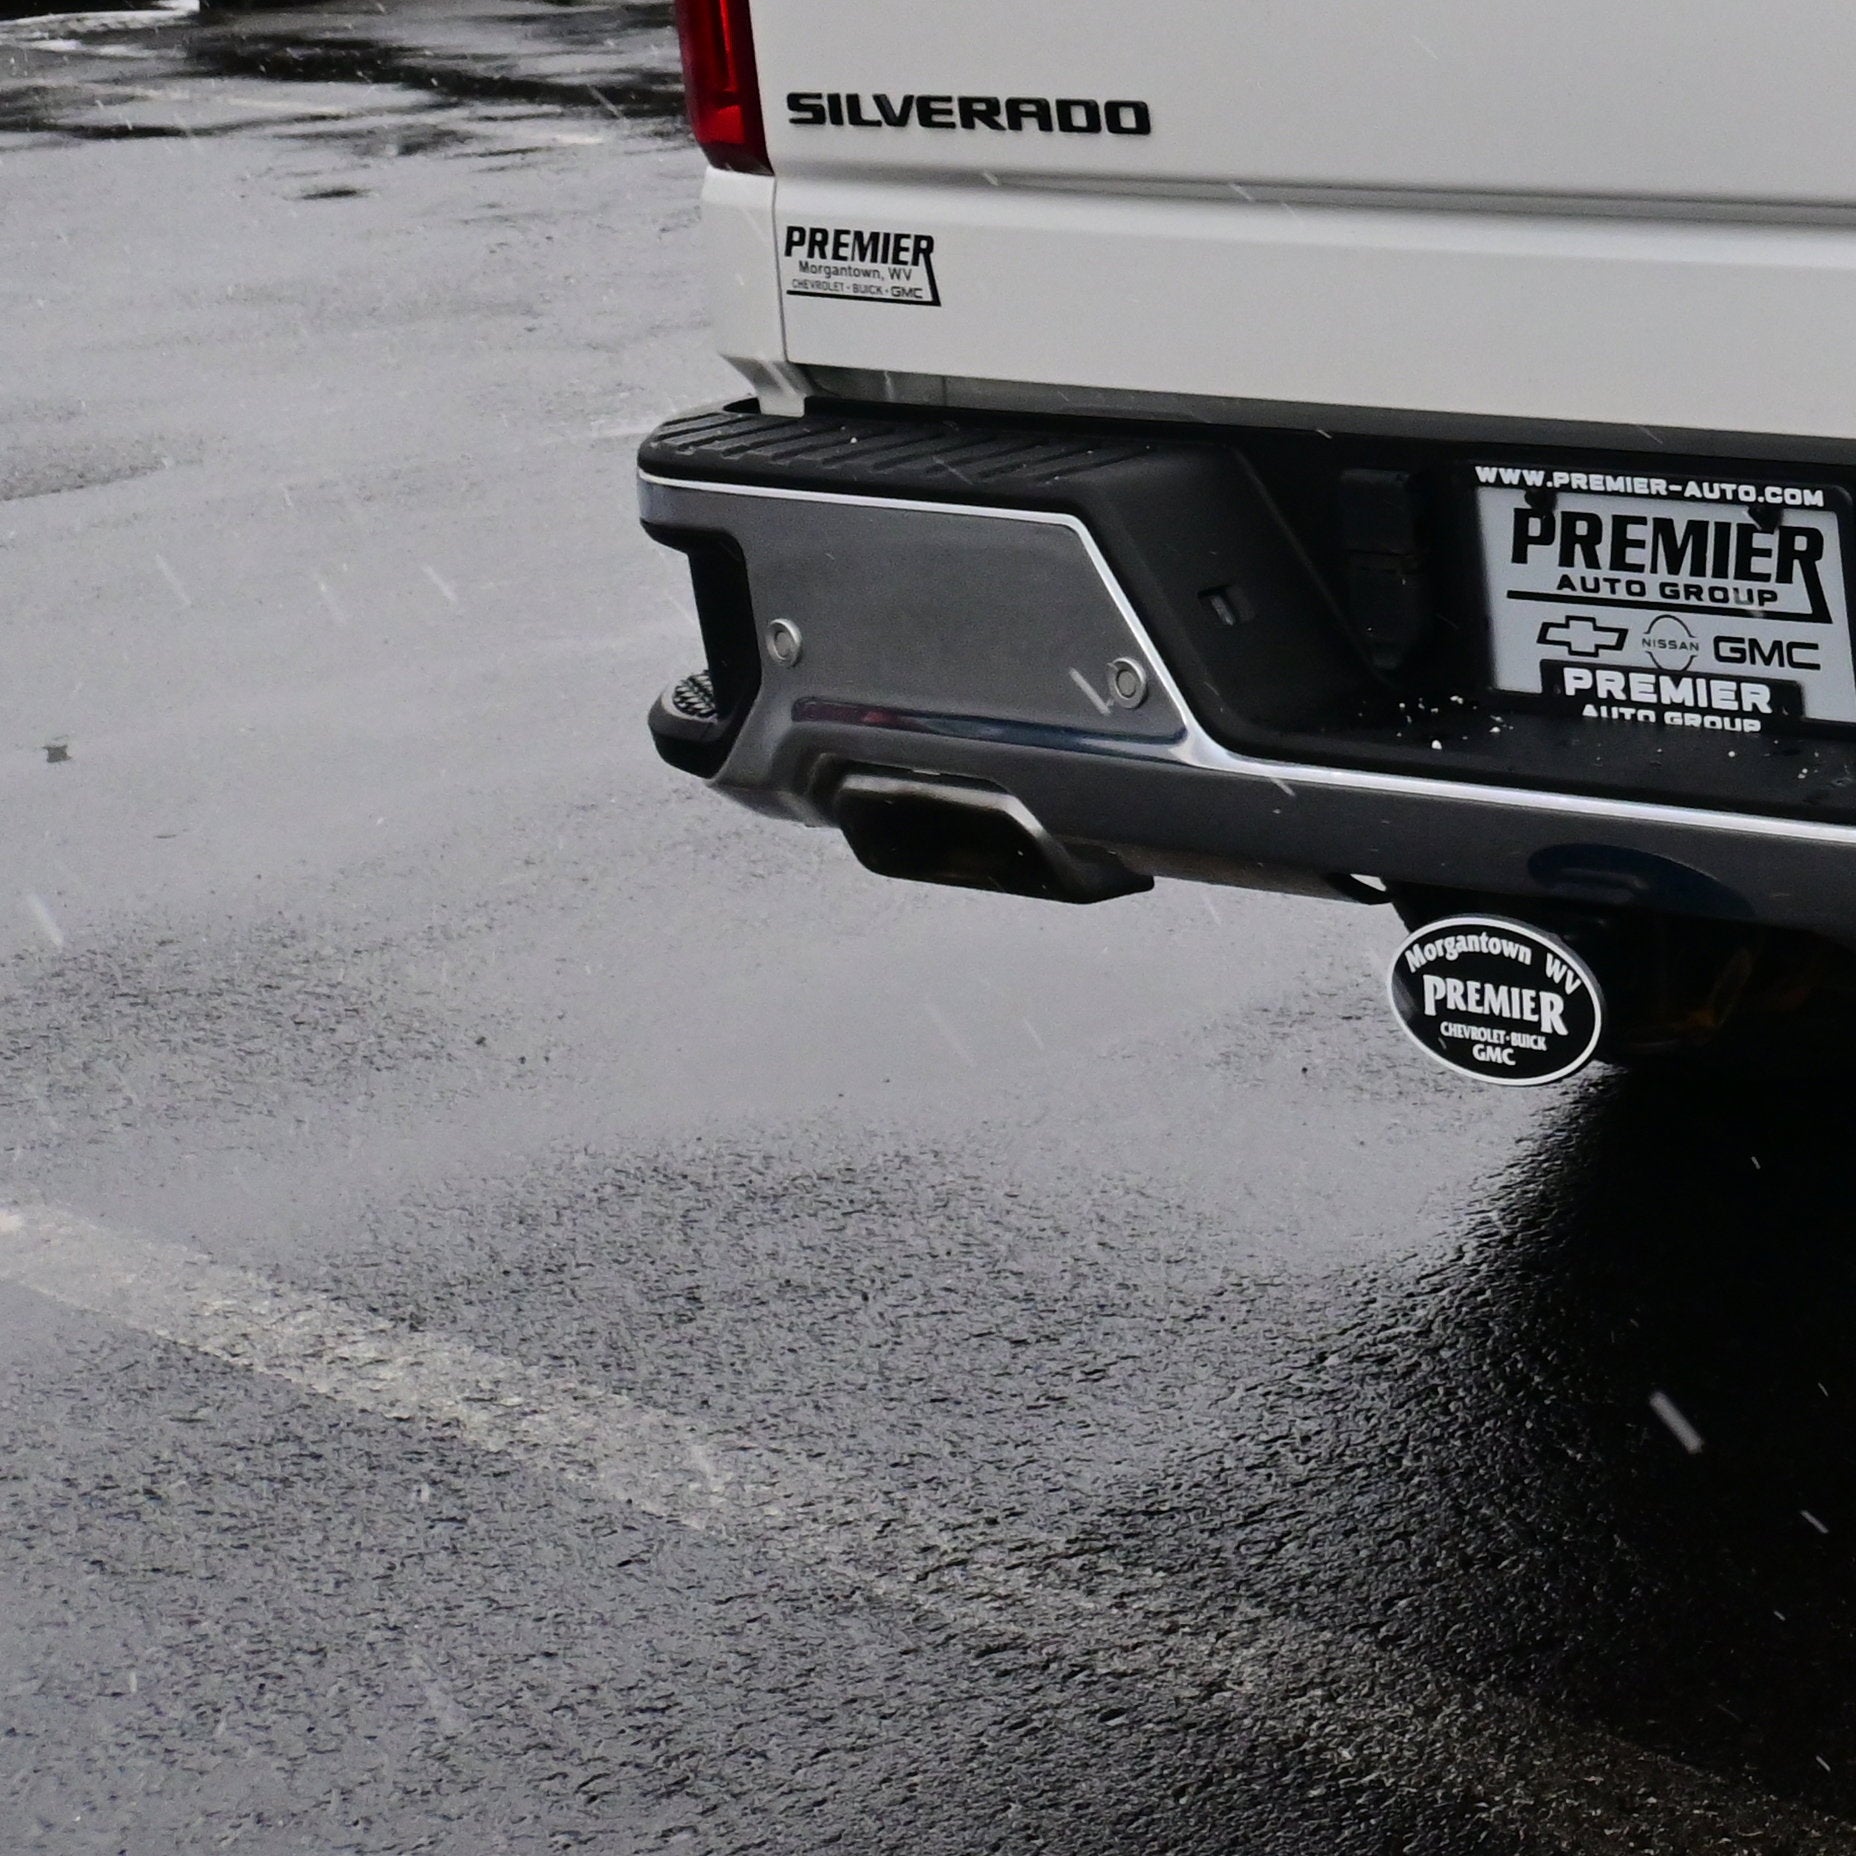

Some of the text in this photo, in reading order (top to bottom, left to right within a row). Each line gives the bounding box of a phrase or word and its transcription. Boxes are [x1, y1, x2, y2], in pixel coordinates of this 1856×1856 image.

[786, 90, 1152, 136] SILVERADO
[784, 225, 935, 267] PREMIER
[791, 278, 924, 299] CHEVROLET BUICK GMC
[798, 260, 912, 282] Morgantown, WV
[1474, 465, 1826, 508] WWW.PREMIER-AUTO.COM
[1510, 506, 1825, 585] PREMIER
[1556, 574, 1779, 608] AUTO GROUP
[1641, 635, 1821, 670] NISSAN GMC
[1562, 666, 1773, 714] PREMIER
[1581, 704, 1762, 733] AUTO GROUP
[1404, 931, 1583, 995] Morgantown WV
[1422, 973, 1569, 1036] PREMIER
[1472, 1043, 1517, 1066] GMC
